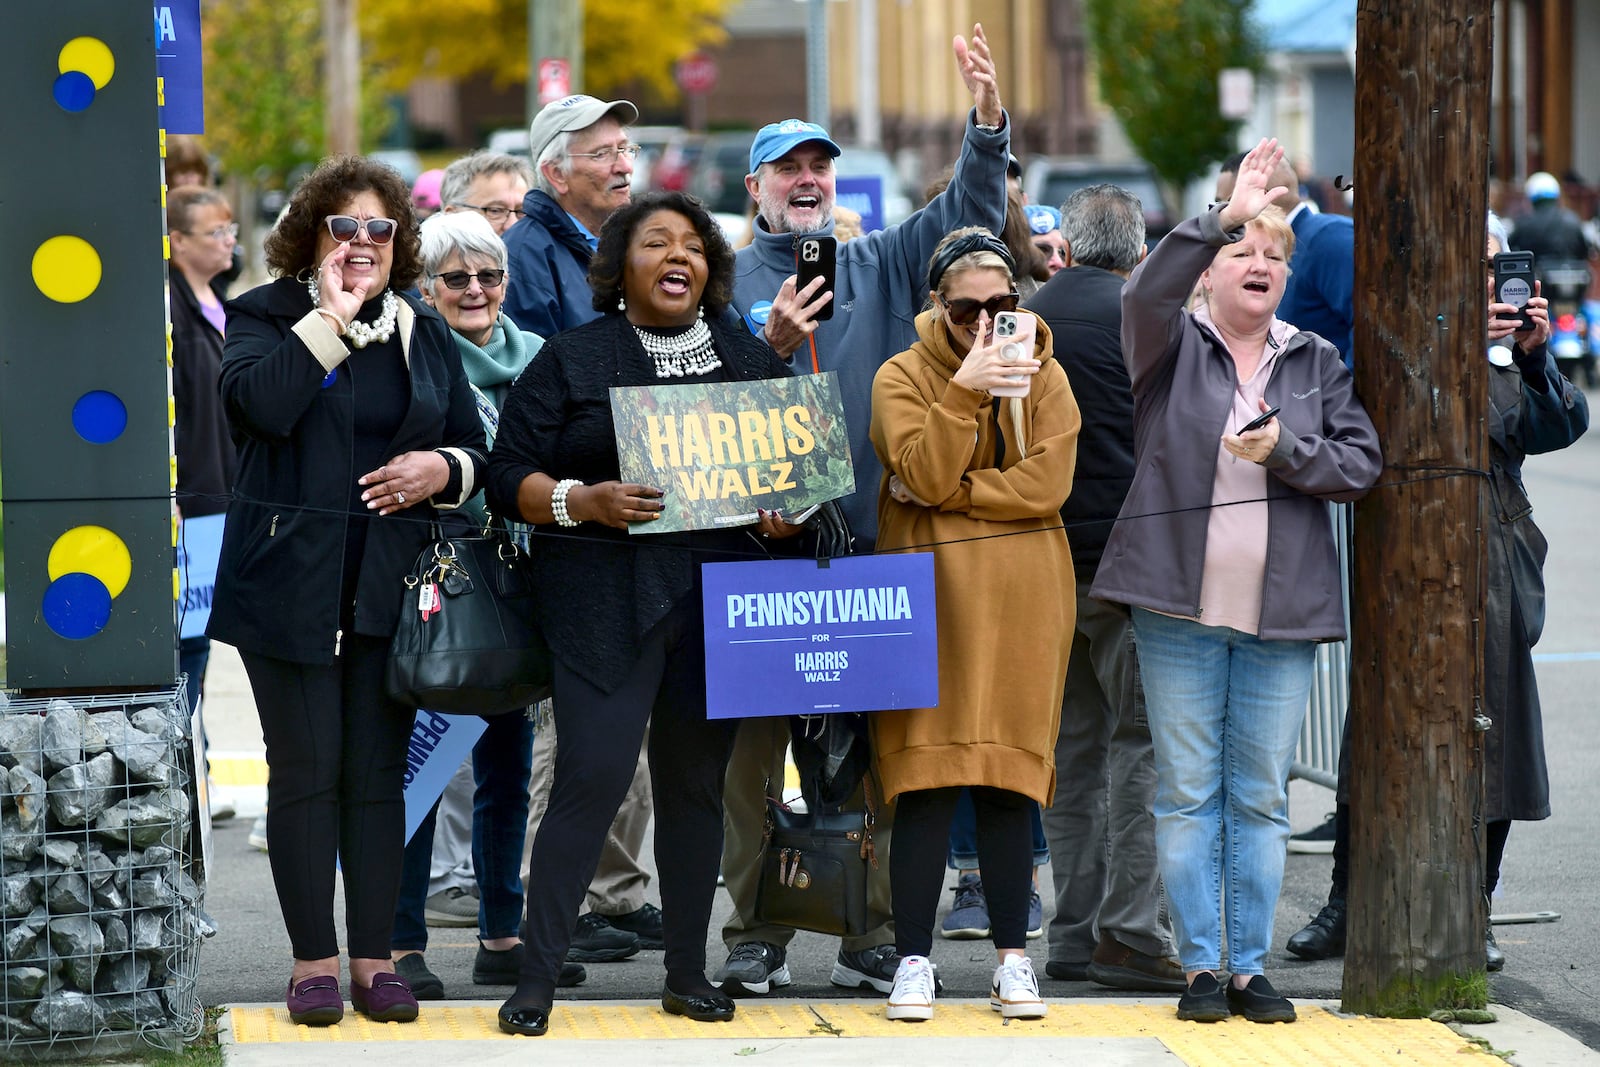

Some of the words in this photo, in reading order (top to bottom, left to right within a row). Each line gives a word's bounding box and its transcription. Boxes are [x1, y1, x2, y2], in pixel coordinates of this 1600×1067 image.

[646, 405, 815, 468] HARRIS
[678, 461, 797, 501] WALZ
[727, 586, 912, 629] PENNSYLVANIA
[811, 634, 830, 643] FOR
[795, 650, 849, 671] HARRIS
[804, 671, 841, 683] WALZ
